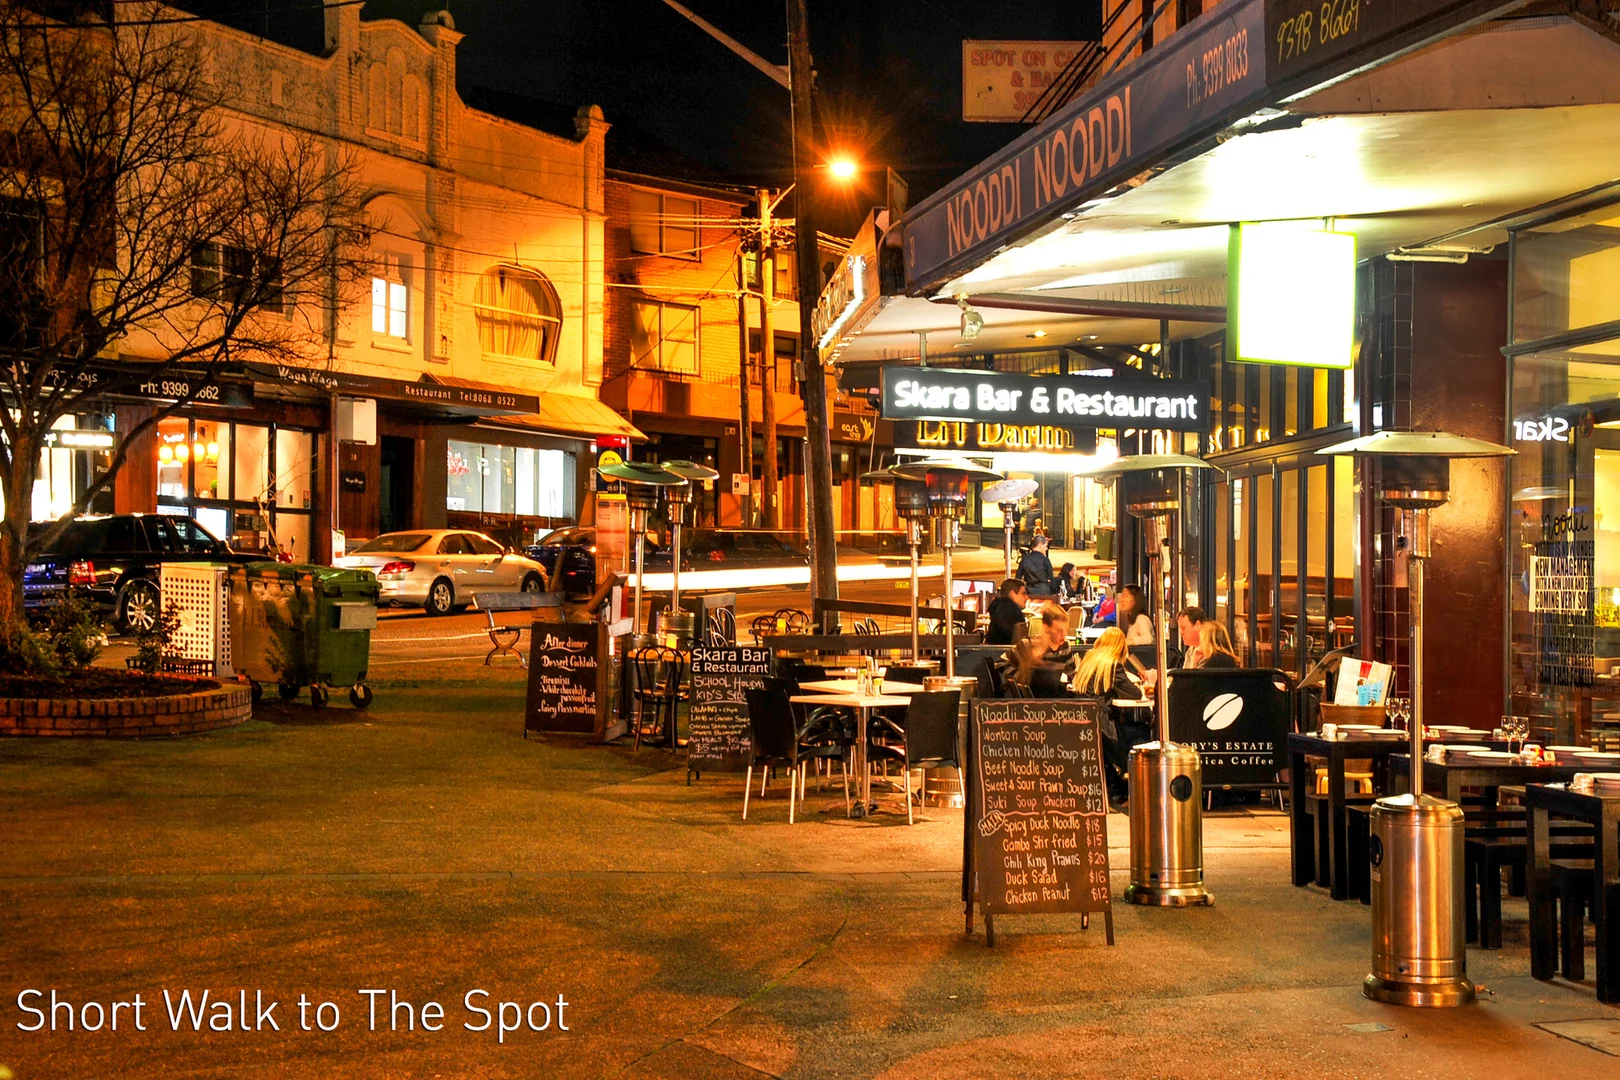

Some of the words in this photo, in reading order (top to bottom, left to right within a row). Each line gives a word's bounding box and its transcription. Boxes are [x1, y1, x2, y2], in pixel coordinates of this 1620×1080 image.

[1277, 10, 1313, 64] 9398
[971, 50, 1016, 67] SPOT
[1022, 50, 1046, 67] ON
[1203, 43, 1223, 99] 9399
[1226, 28, 1248, 85] 8033
[1010, 71, 1024, 87] &
[947, 158, 1022, 257] NOODDI
[1034, 85, 1132, 209] NOODDI
[278, 366, 307, 384] Waga
[162, 381, 189, 396] 9399
[405, 385, 451, 399] Restaurant
[497, 396, 516, 406] 0522
[894, 380, 970, 410] Skara
[977, 383, 1022, 413] Bar
[1030, 387, 1050, 413] &
[1056, 386, 1199, 420] Restaurant
[1536, 558, 1549, 575] NEW
[1551, 558, 1594, 575] MANAGEMENT
[1536, 577, 1547, 590] WITH
[1552, 577, 1562, 590] NEW
[1563, 577, 1574, 590] LOOK
[1575, 577, 1584, 590] AND
[1535, 591, 1559, 609] COMING
[1561, 591, 1576, 609] VERY
[566, 636, 588, 648] dinner
[541, 655, 568, 667] Dessert
[570, 655, 597, 668] Cocktails
[692, 648, 737, 661] Skara
[742, 649, 769, 661] Bar
[692, 662, 700, 672] &
[704, 662, 769, 673] Restaurant
[541, 675, 570, 685] Tiramisu
[694, 675, 731, 688] SCHOOL
[696, 690, 723, 701] KID'S
[1023, 704, 1046, 726] Soup
[1052, 704, 1088, 726] Specials
[983, 727, 1018, 741] Wonton
[1023, 726, 1046, 743] Soup
[1079, 729, 1093, 741] $8
[983, 744, 1020, 757] Chicken
[1024, 745, 1054, 759] Noodle
[1057, 745, 1078, 763] Soup
[1081, 749, 1096, 761] $12
[1177, 742, 1219, 750] OBY'S
[1226, 742, 1274, 750] ESTATE
[985, 760, 1007, 775] Beef
[1010, 761, 1040, 776] Noodle
[1042, 761, 1064, 778] Soup
[1082, 765, 1099, 777] $12
[1231, 756, 1274, 765] Coffee
[985, 779, 1007, 792] Sweet
[1016, 777, 1035, 792] Sour
[1040, 778, 1063, 793] Prawn
[1067, 779, 1088, 798] Soup
[1088, 783, 1101, 795] $16
[987, 796, 1007, 809] Suki
[1016, 795, 1036, 811] Soup
[1043, 795, 1075, 808] Chicken
[1086, 799, 1102, 811] $12
[981, 812, 1004, 832] MAIN
[1004, 819, 1027, 837] Spicy
[1030, 817, 1049, 830] Duck
[1085, 818, 1100, 832] $18
[1003, 838, 1030, 851] Combo
[1033, 835, 1048, 848] Stir
[1086, 834, 1103, 846] $15
[1004, 854, 1022, 868] Chili
[1027, 853, 1047, 874] King
[1052, 850, 1080, 866] Prawns
[1088, 850, 1106, 865] $20
[1005, 871, 1028, 885] Duck
[1032, 868, 1057, 884] Salad
[1089, 870, 1106, 883] $16
[1005, 888, 1038, 904] Chicken
[1042, 883, 1070, 900] Peanut
[1091, 887, 1108, 901] $12
